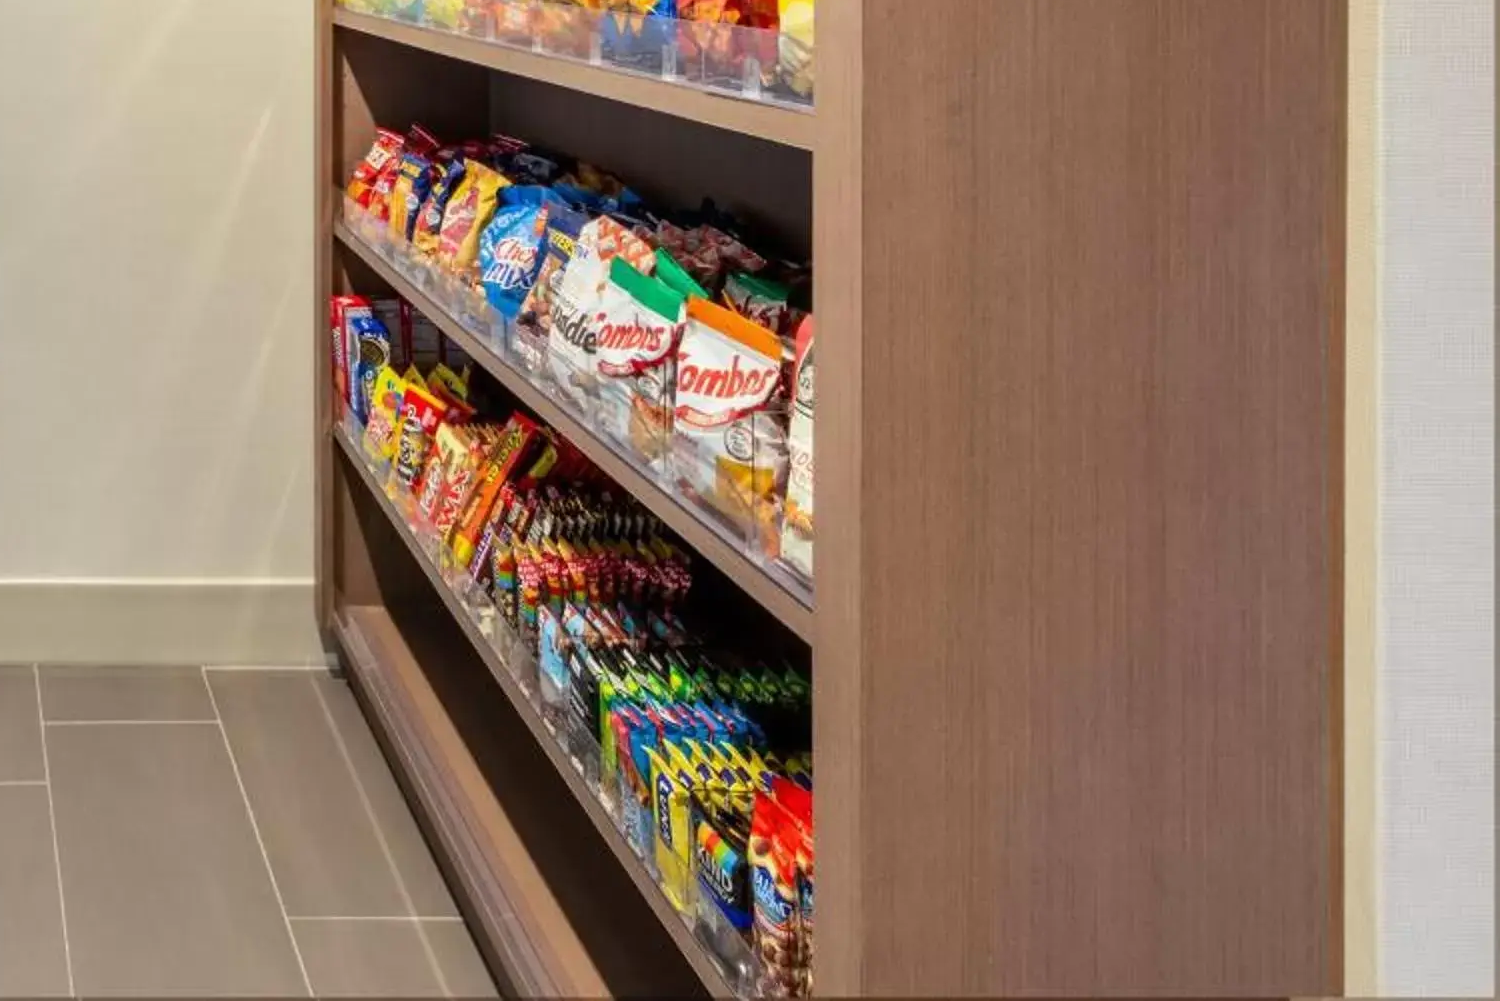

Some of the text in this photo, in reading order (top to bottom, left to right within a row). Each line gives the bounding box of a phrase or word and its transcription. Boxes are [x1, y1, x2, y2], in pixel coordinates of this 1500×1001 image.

[597, 312, 665, 352] ombos
[678, 354, 778, 399] ombos
[699, 846, 734, 893] KIND
